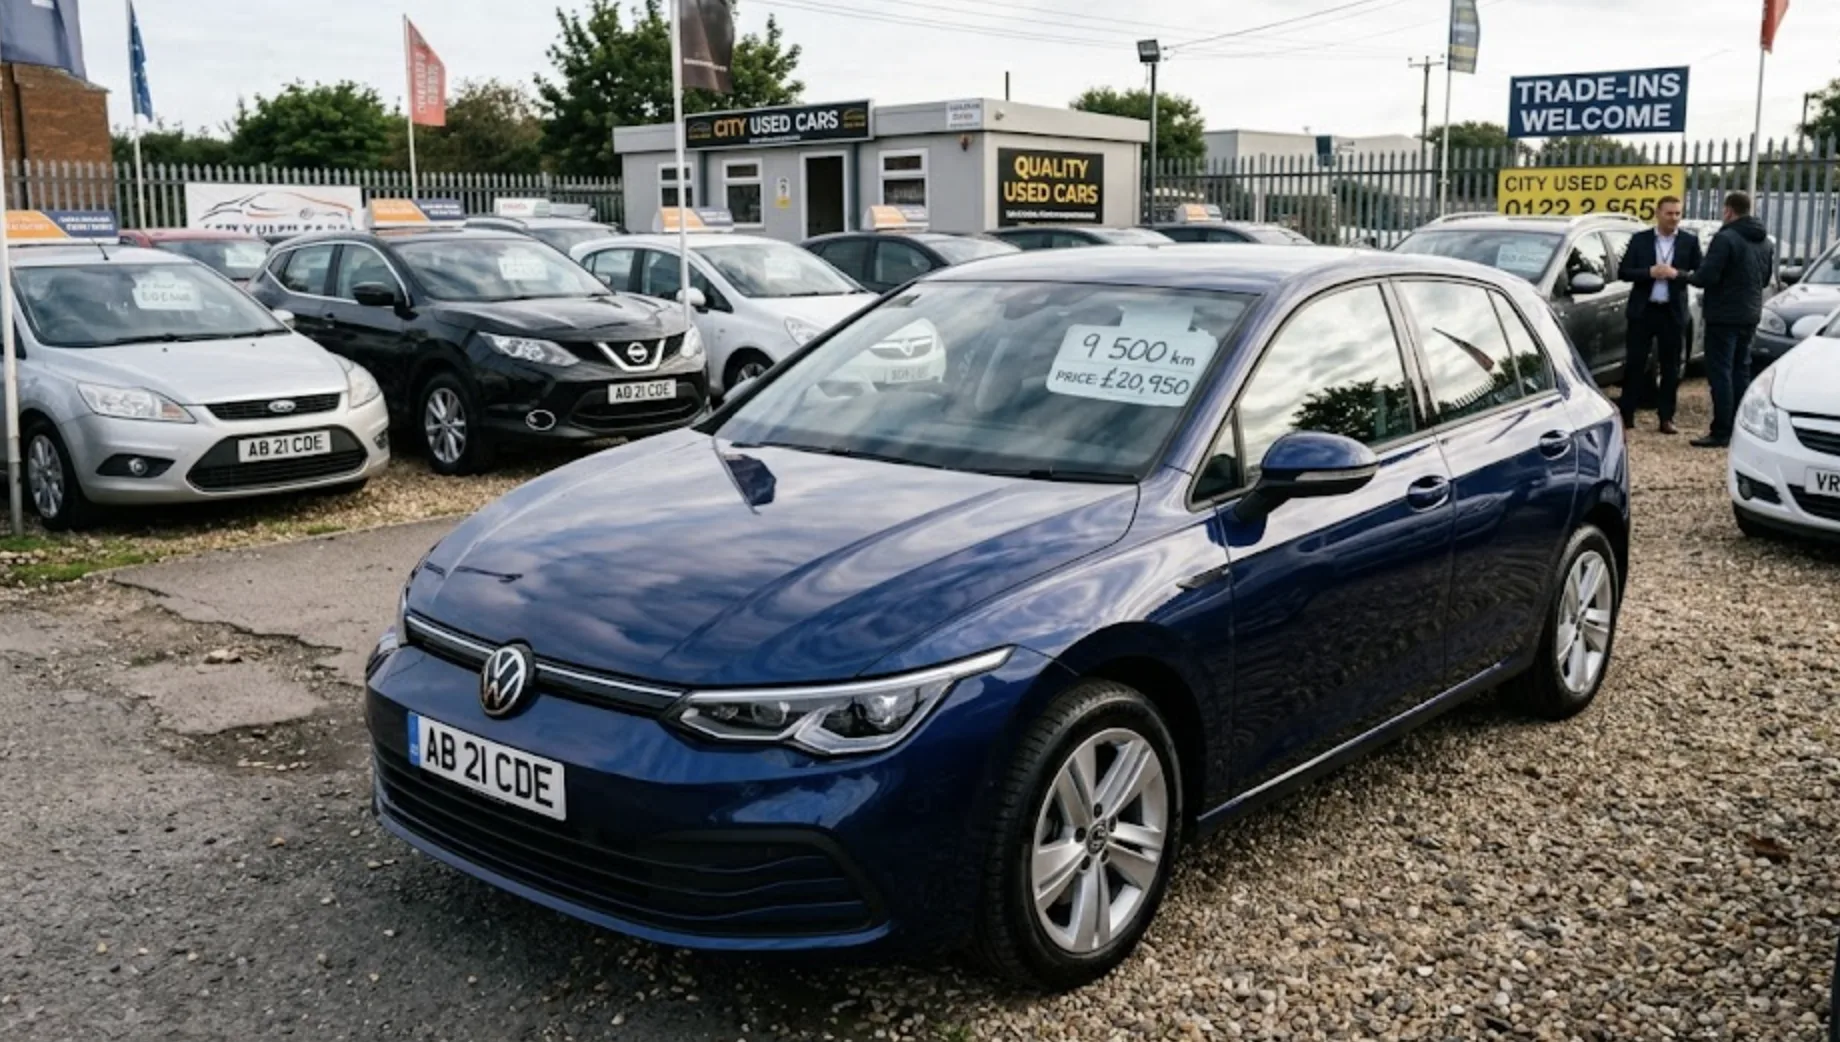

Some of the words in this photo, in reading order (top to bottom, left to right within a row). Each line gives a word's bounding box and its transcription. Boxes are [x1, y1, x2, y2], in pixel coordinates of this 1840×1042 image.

[1516, 73, 1681, 104] TRADE-INS
[714, 118, 747, 137] CITY
[750, 114, 790, 135] USED
[795, 110, 838, 132] CARS
[1520, 104, 1672, 132] WELCOME
[1014, 155, 1088, 179] QUALITY
[1003, 181, 1050, 202] USED
[1054, 183, 1098, 204] CARS
[1505, 176, 1547, 192] CITY
[1554, 175, 1607, 191] USED
[1614, 173, 1673, 190] CARS
[1083, 333, 1100, 358] 9
[1108, 337, 1168, 363] 500
[1170, 350, 1195, 366] km
[1100, 366, 1190, 395] £20,950
[248, 441, 269, 457] AB
[273, 438, 288, 455] 21
[425, 725, 457, 772] AB
[463, 741, 487, 785] 21
[495, 752, 553, 809] CDE
